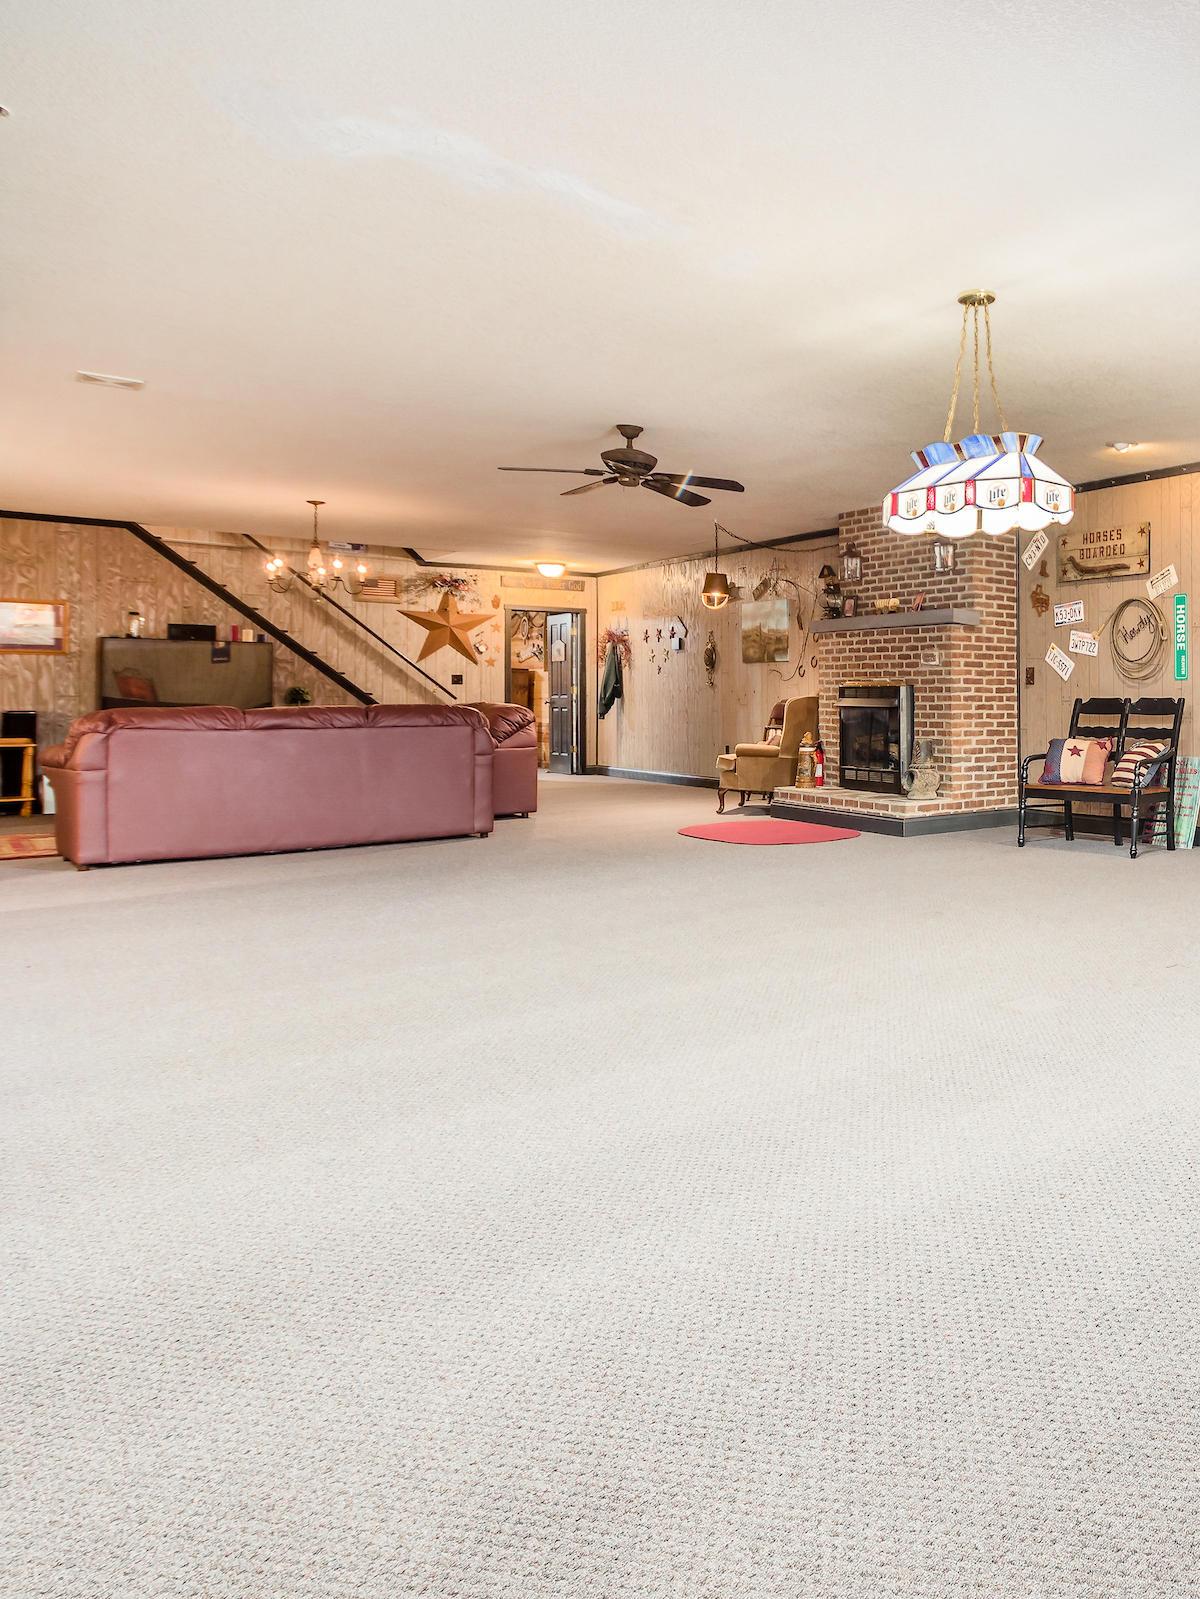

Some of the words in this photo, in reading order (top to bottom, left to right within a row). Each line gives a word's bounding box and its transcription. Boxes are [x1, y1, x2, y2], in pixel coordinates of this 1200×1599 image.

[944, 492, 956, 508] Lite
[989, 487, 1007, 503] Lite
[1046, 491, 1060, 505] Lite
[906, 497, 918, 513] Lite
[1082, 528, 1122, 545] HORSES
[1079, 543, 1125, 560] BOARDED
[1117, 613, 1155, 644] Howdy
[1176, 605, 1186, 651] HORSE
